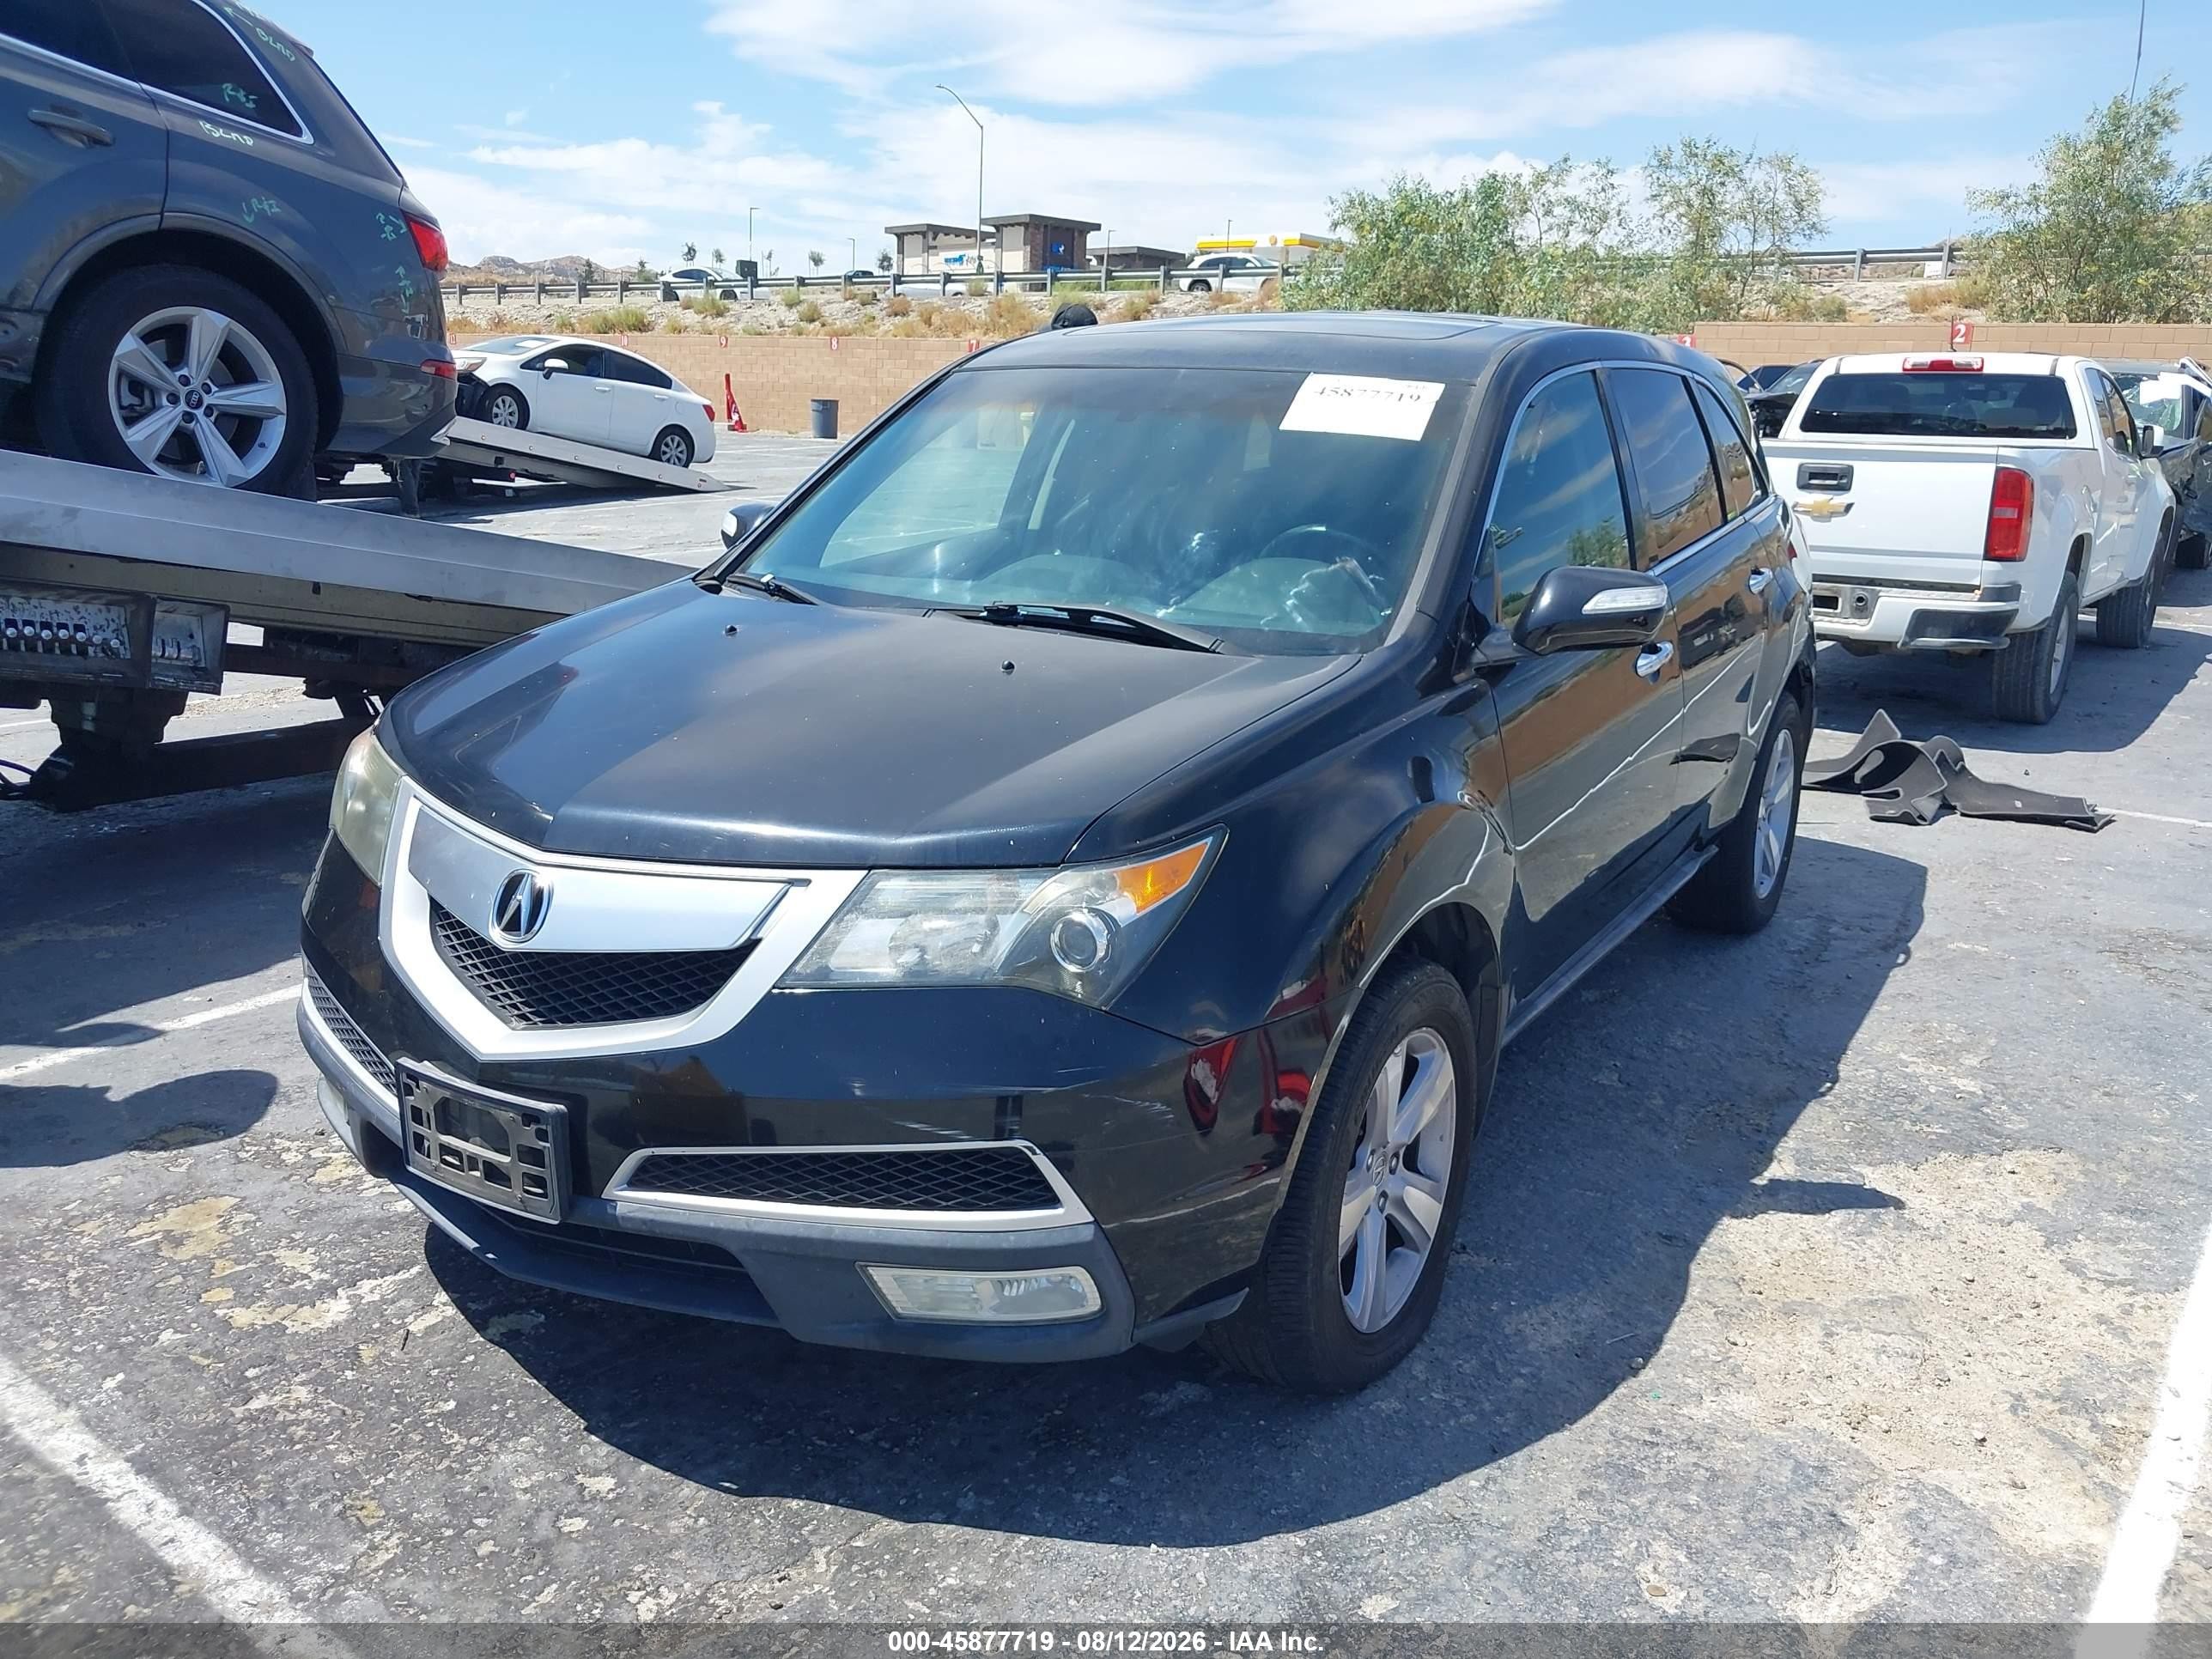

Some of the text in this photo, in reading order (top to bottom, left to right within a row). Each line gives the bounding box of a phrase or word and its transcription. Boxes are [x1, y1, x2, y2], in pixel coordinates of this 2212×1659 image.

[1952, 324, 1966, 343] 2
[720, 336, 726, 348] 9
[831, 336, 838, 350] 8
[1314, 386, 1421, 402] 45877719
